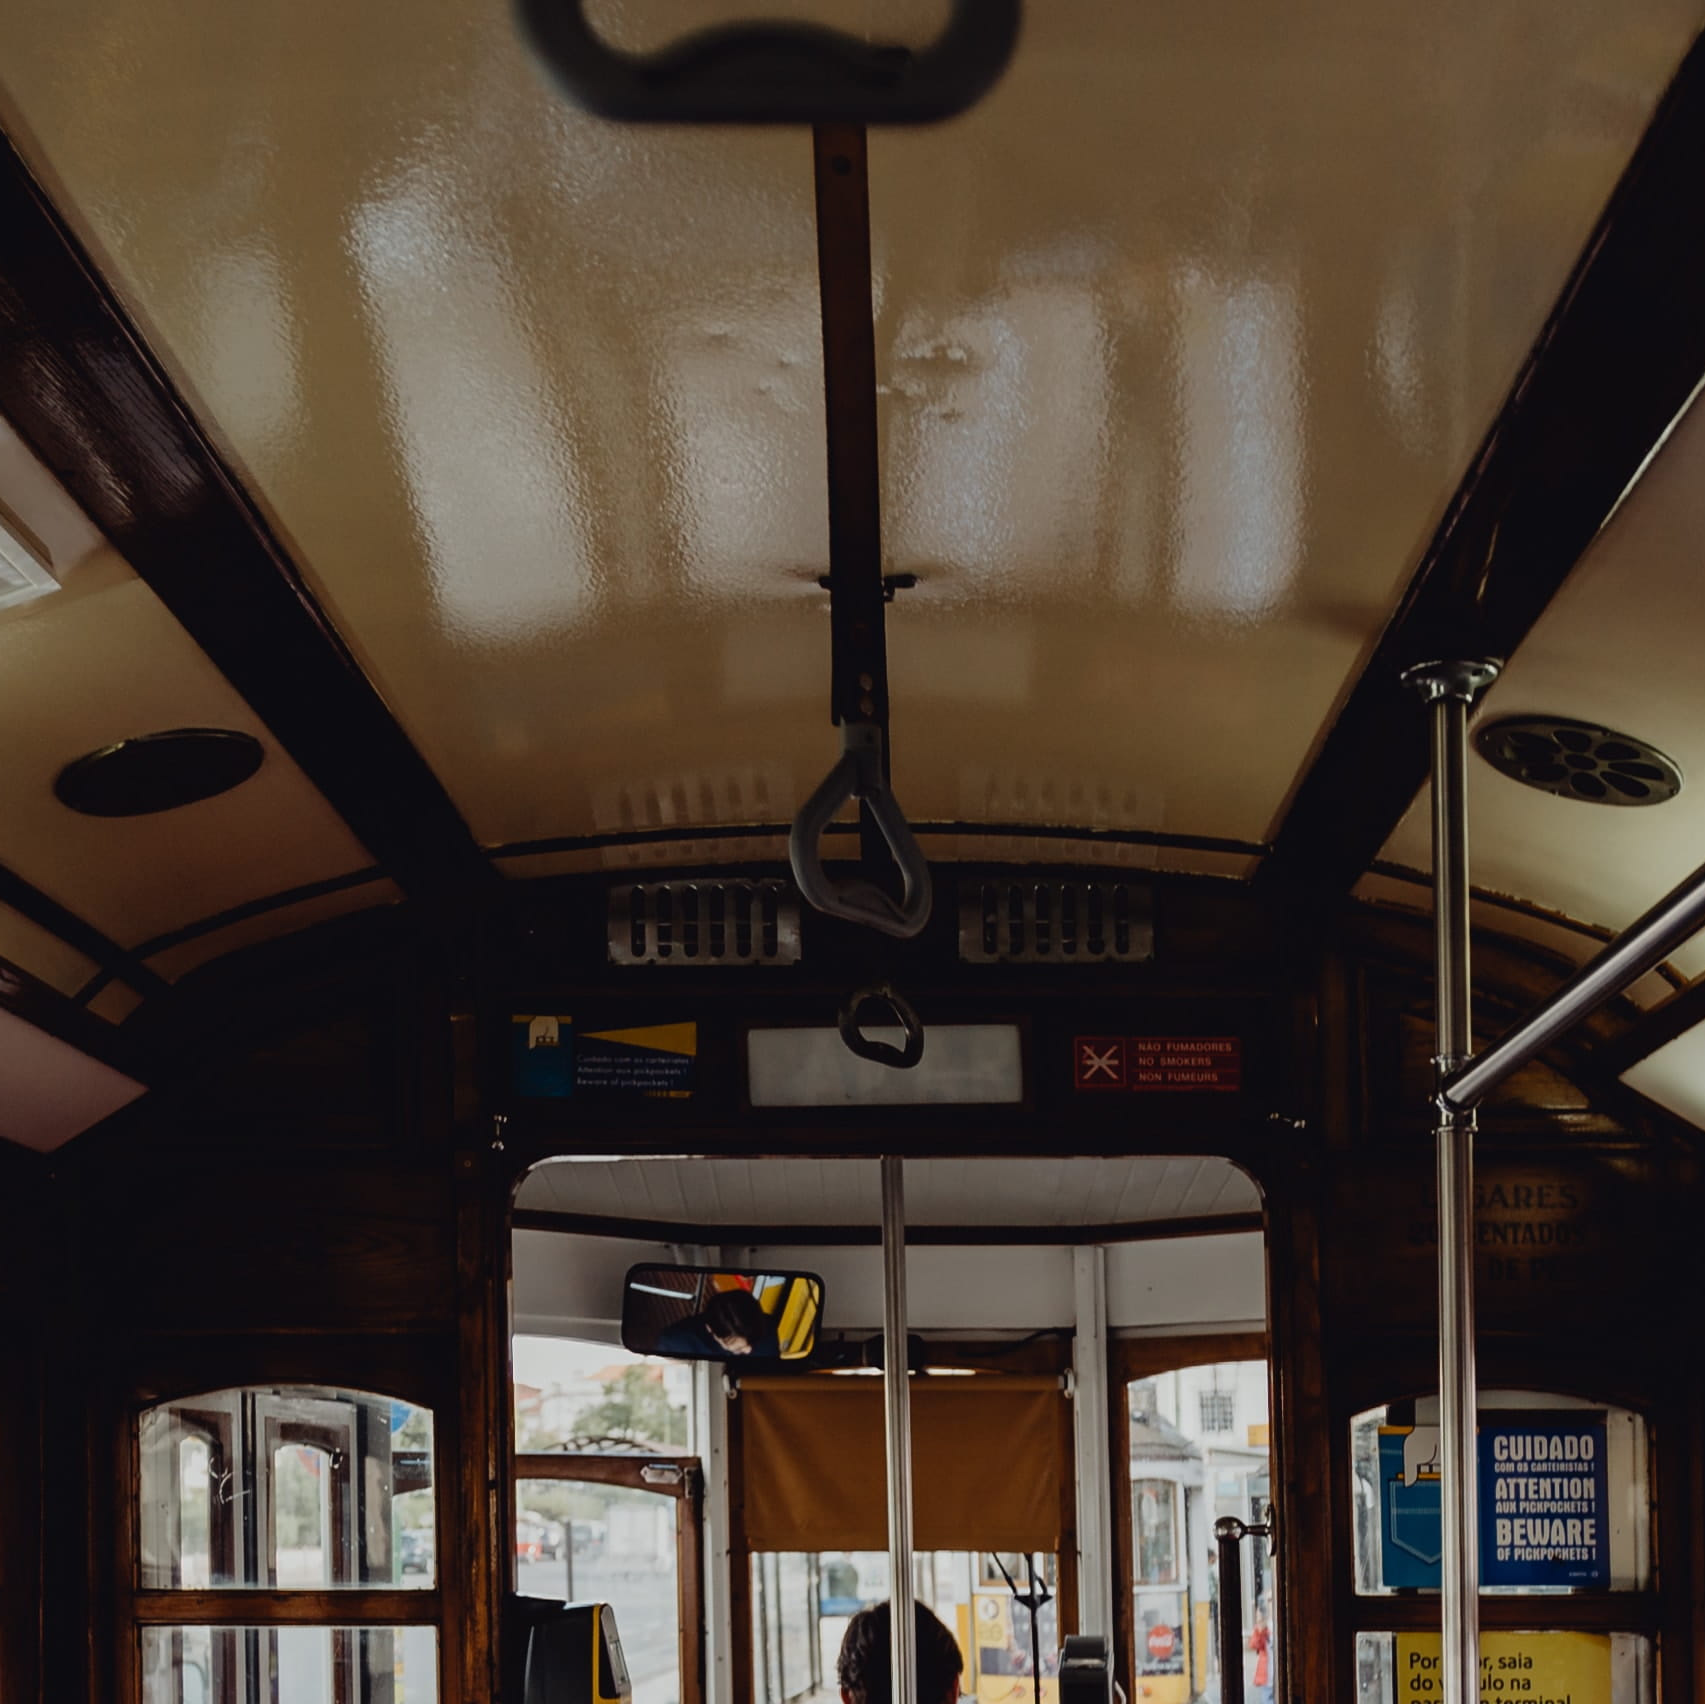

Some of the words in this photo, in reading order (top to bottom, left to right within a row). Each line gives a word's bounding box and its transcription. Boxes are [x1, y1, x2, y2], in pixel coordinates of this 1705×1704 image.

[1138, 1040, 1161, 1051] NÃO
[1167, 1042, 1232, 1052] FUMADORES
[1139, 1057, 1155, 1066] NO
[1160, 1057, 1213, 1067] SMOKERS
[577, 1077, 608, 1085] Beware
[1138, 1072, 1162, 1081] NON
[1168, 1072, 1218, 1082] FUMEURS
[1494, 1435, 1594, 1461] CUIDADO
[1495, 1462, 1515, 1473] COM
[1517, 1462, 1529, 1473] OS
[1530, 1462, 1588, 1473] CARTEIRISTAS
[1495, 1477, 1595, 1500] ATTENTION
[1496, 1501, 1517, 1514] AUX
[1520, 1501, 1589, 1514] PICKPOCKETS
[1496, 1518, 1596, 1546] BEWARE
[1497, 1547, 1511, 1561] OF
[1514, 1547, 1589, 1561] PICKPOCKETS
[1409, 1652, 1439, 1669] Por
[1498, 1652, 1533, 1669] saia
[1410, 1673, 1433, 1690] do
[1510, 1677, 1531, 1690] na
